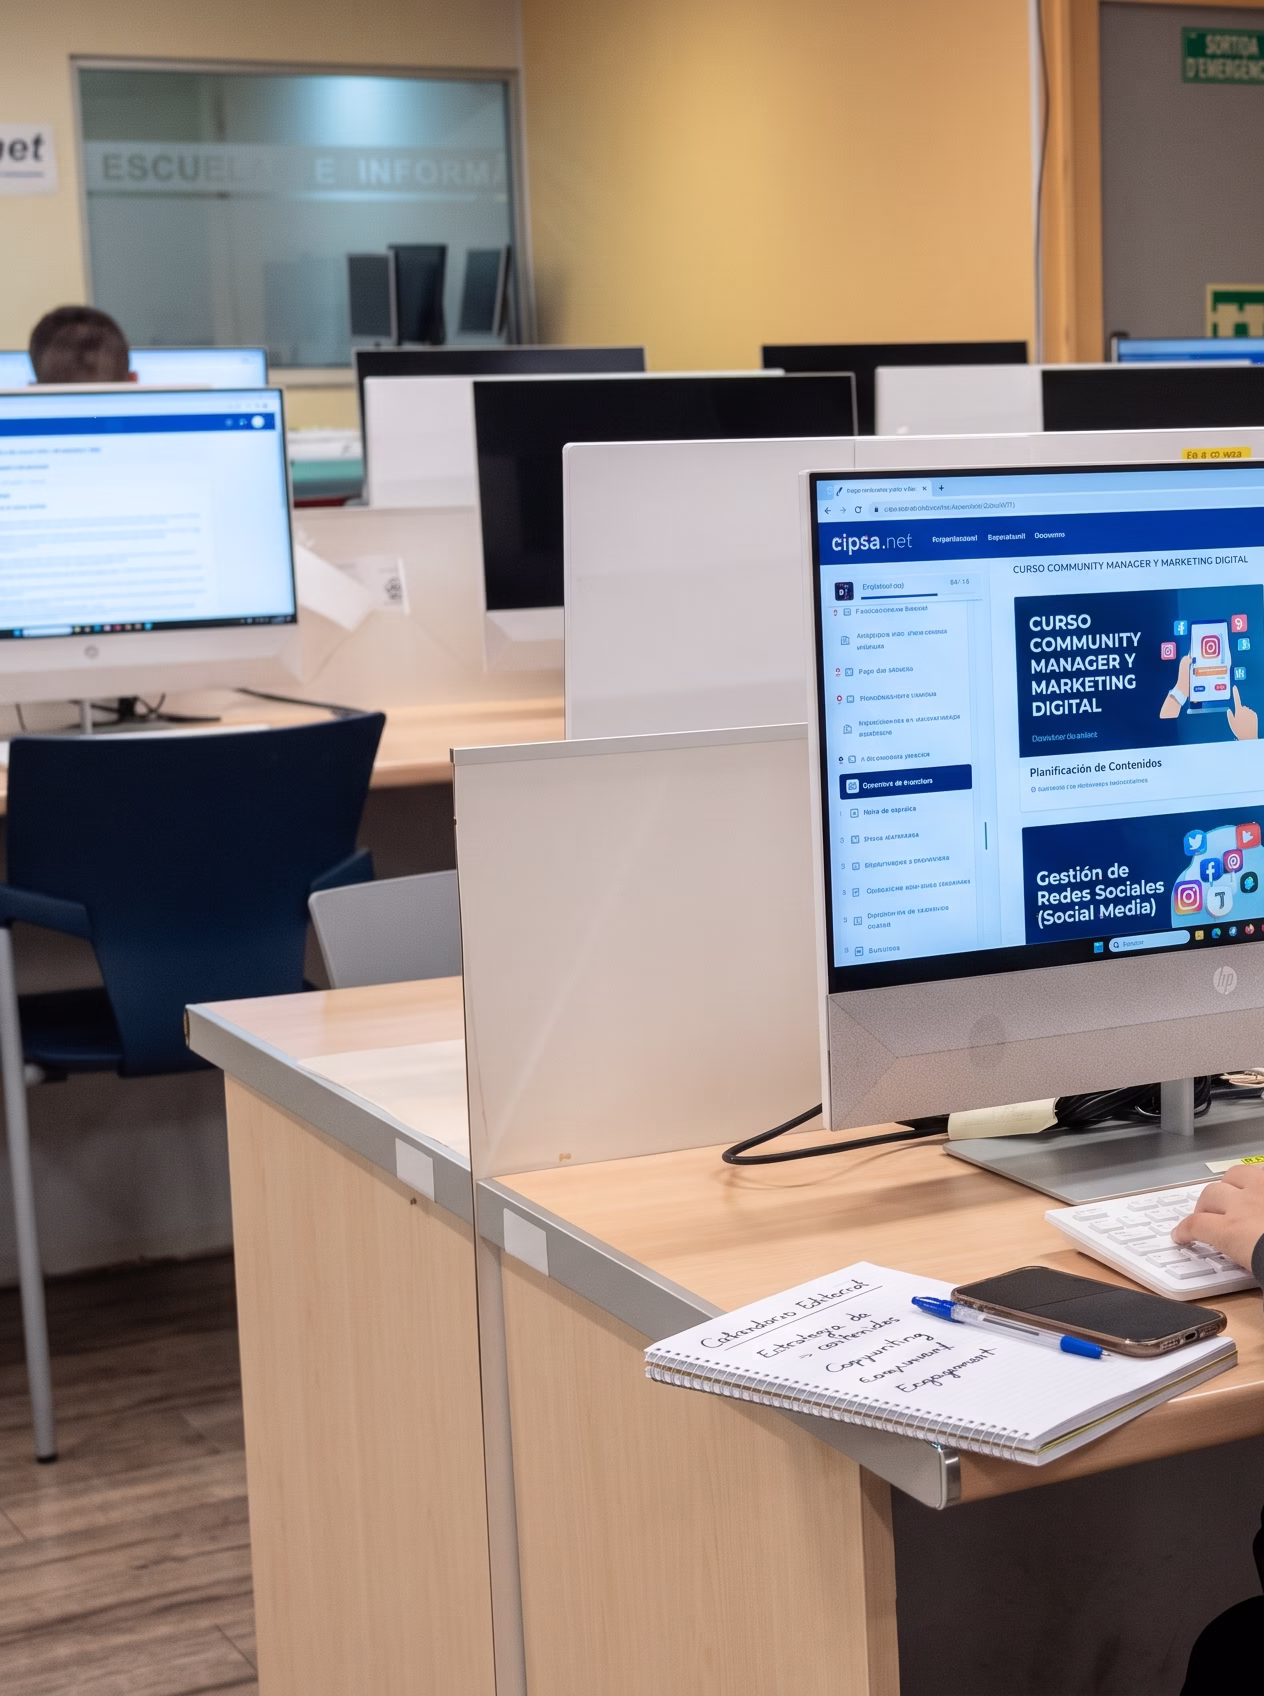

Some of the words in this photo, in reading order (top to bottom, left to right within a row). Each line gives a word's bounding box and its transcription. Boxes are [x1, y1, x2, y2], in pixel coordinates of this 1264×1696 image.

[831, 533, 913, 556] cipsa.net
[1013, 564, 1045, 575] CURSO
[1047, 561, 1104, 573] COMMUNITY
[1106, 559, 1151, 570] MANAGER
[1153, 558, 1159, 568] Y
[1160, 556, 1213, 567] MARKETING
[1215, 554, 1248, 565] DIGITAL
[1028, 613, 1092, 632] CURSO
[1029, 631, 1142, 653] COMMUNITY
[1030, 655, 1120, 675] MANAGER
[1124, 653, 1136, 669] Y
[1031, 674, 1137, 696] MARKETING
[1032, 697, 1102, 717] DIGITAL
[1029, 763, 1092, 778] Planificación
[1094, 762, 1106, 773] de
[1108, 758, 1162, 772] Contenidos
[1036, 865, 1103, 887] Gestión
[1107, 862, 1129, 879] de
[1037, 886, 1091, 906] Redes
[1095, 879, 1165, 900] Sociales
[1037, 905, 1094, 930] (Social
[1099, 898, 1157, 919] Media)
[1213, 965, 1238, 995] hp
